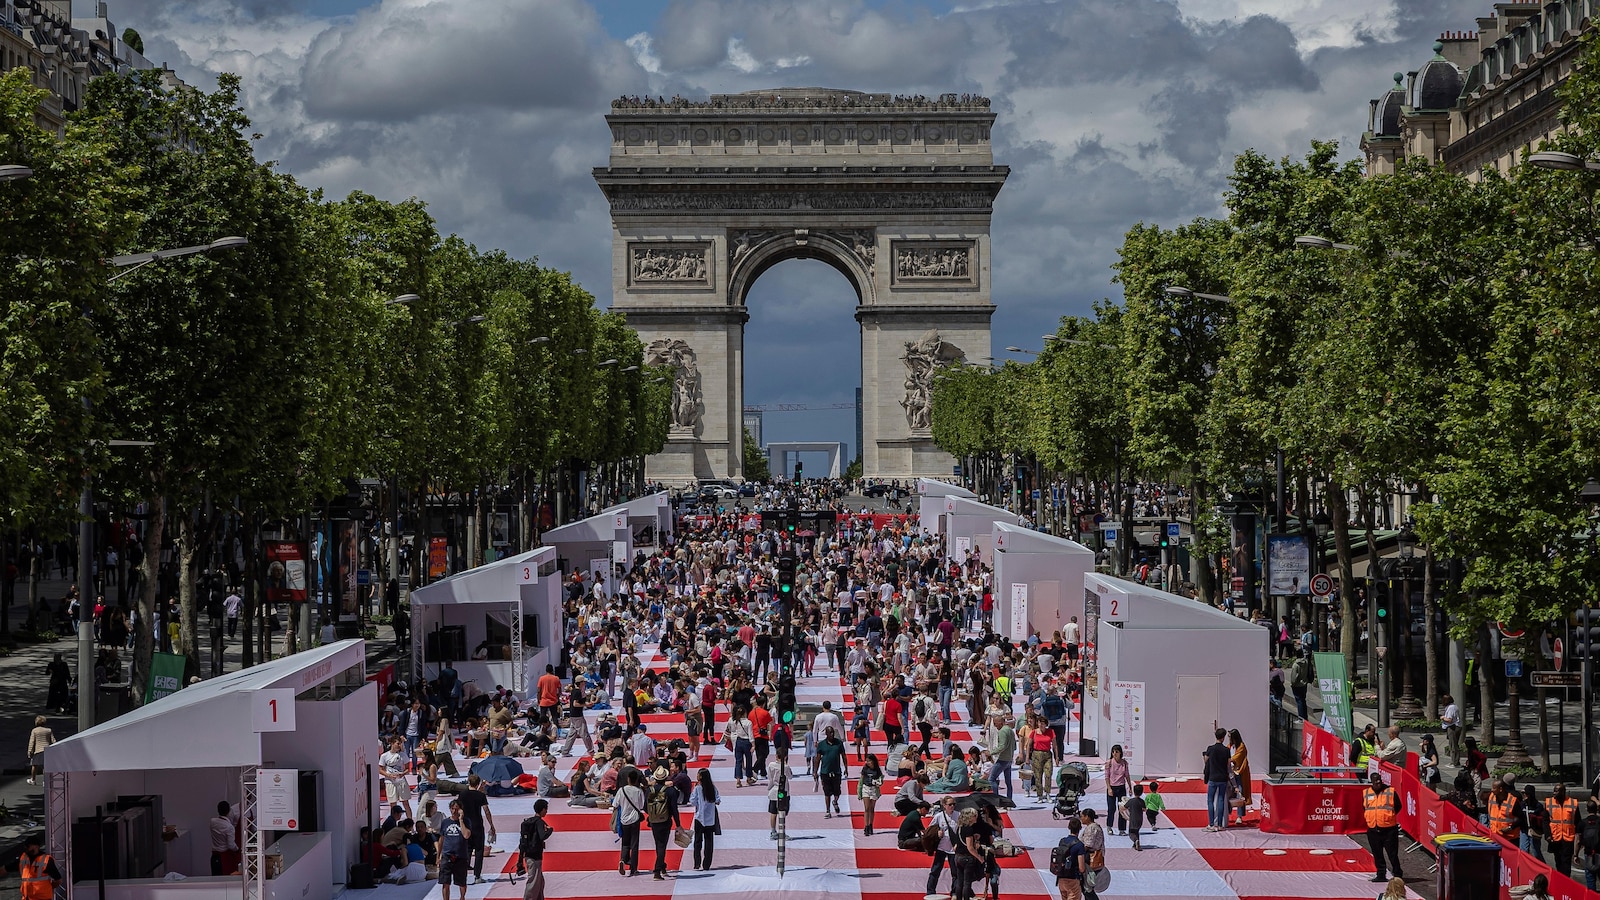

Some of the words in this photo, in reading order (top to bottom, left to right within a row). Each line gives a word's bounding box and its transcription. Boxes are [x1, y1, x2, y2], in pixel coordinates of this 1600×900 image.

[617, 518, 622, 526] 5
[997, 535, 1002, 545] 4
[524, 567, 530, 580] 3
[1316, 581, 1328, 590] 50
[1111, 600, 1118, 615] 2
[269, 699, 276, 722] 1
[1322, 799, 1334, 807] ICI,
[1315, 807, 1326, 815] ON
[1326, 807, 1342, 815] BOIT
